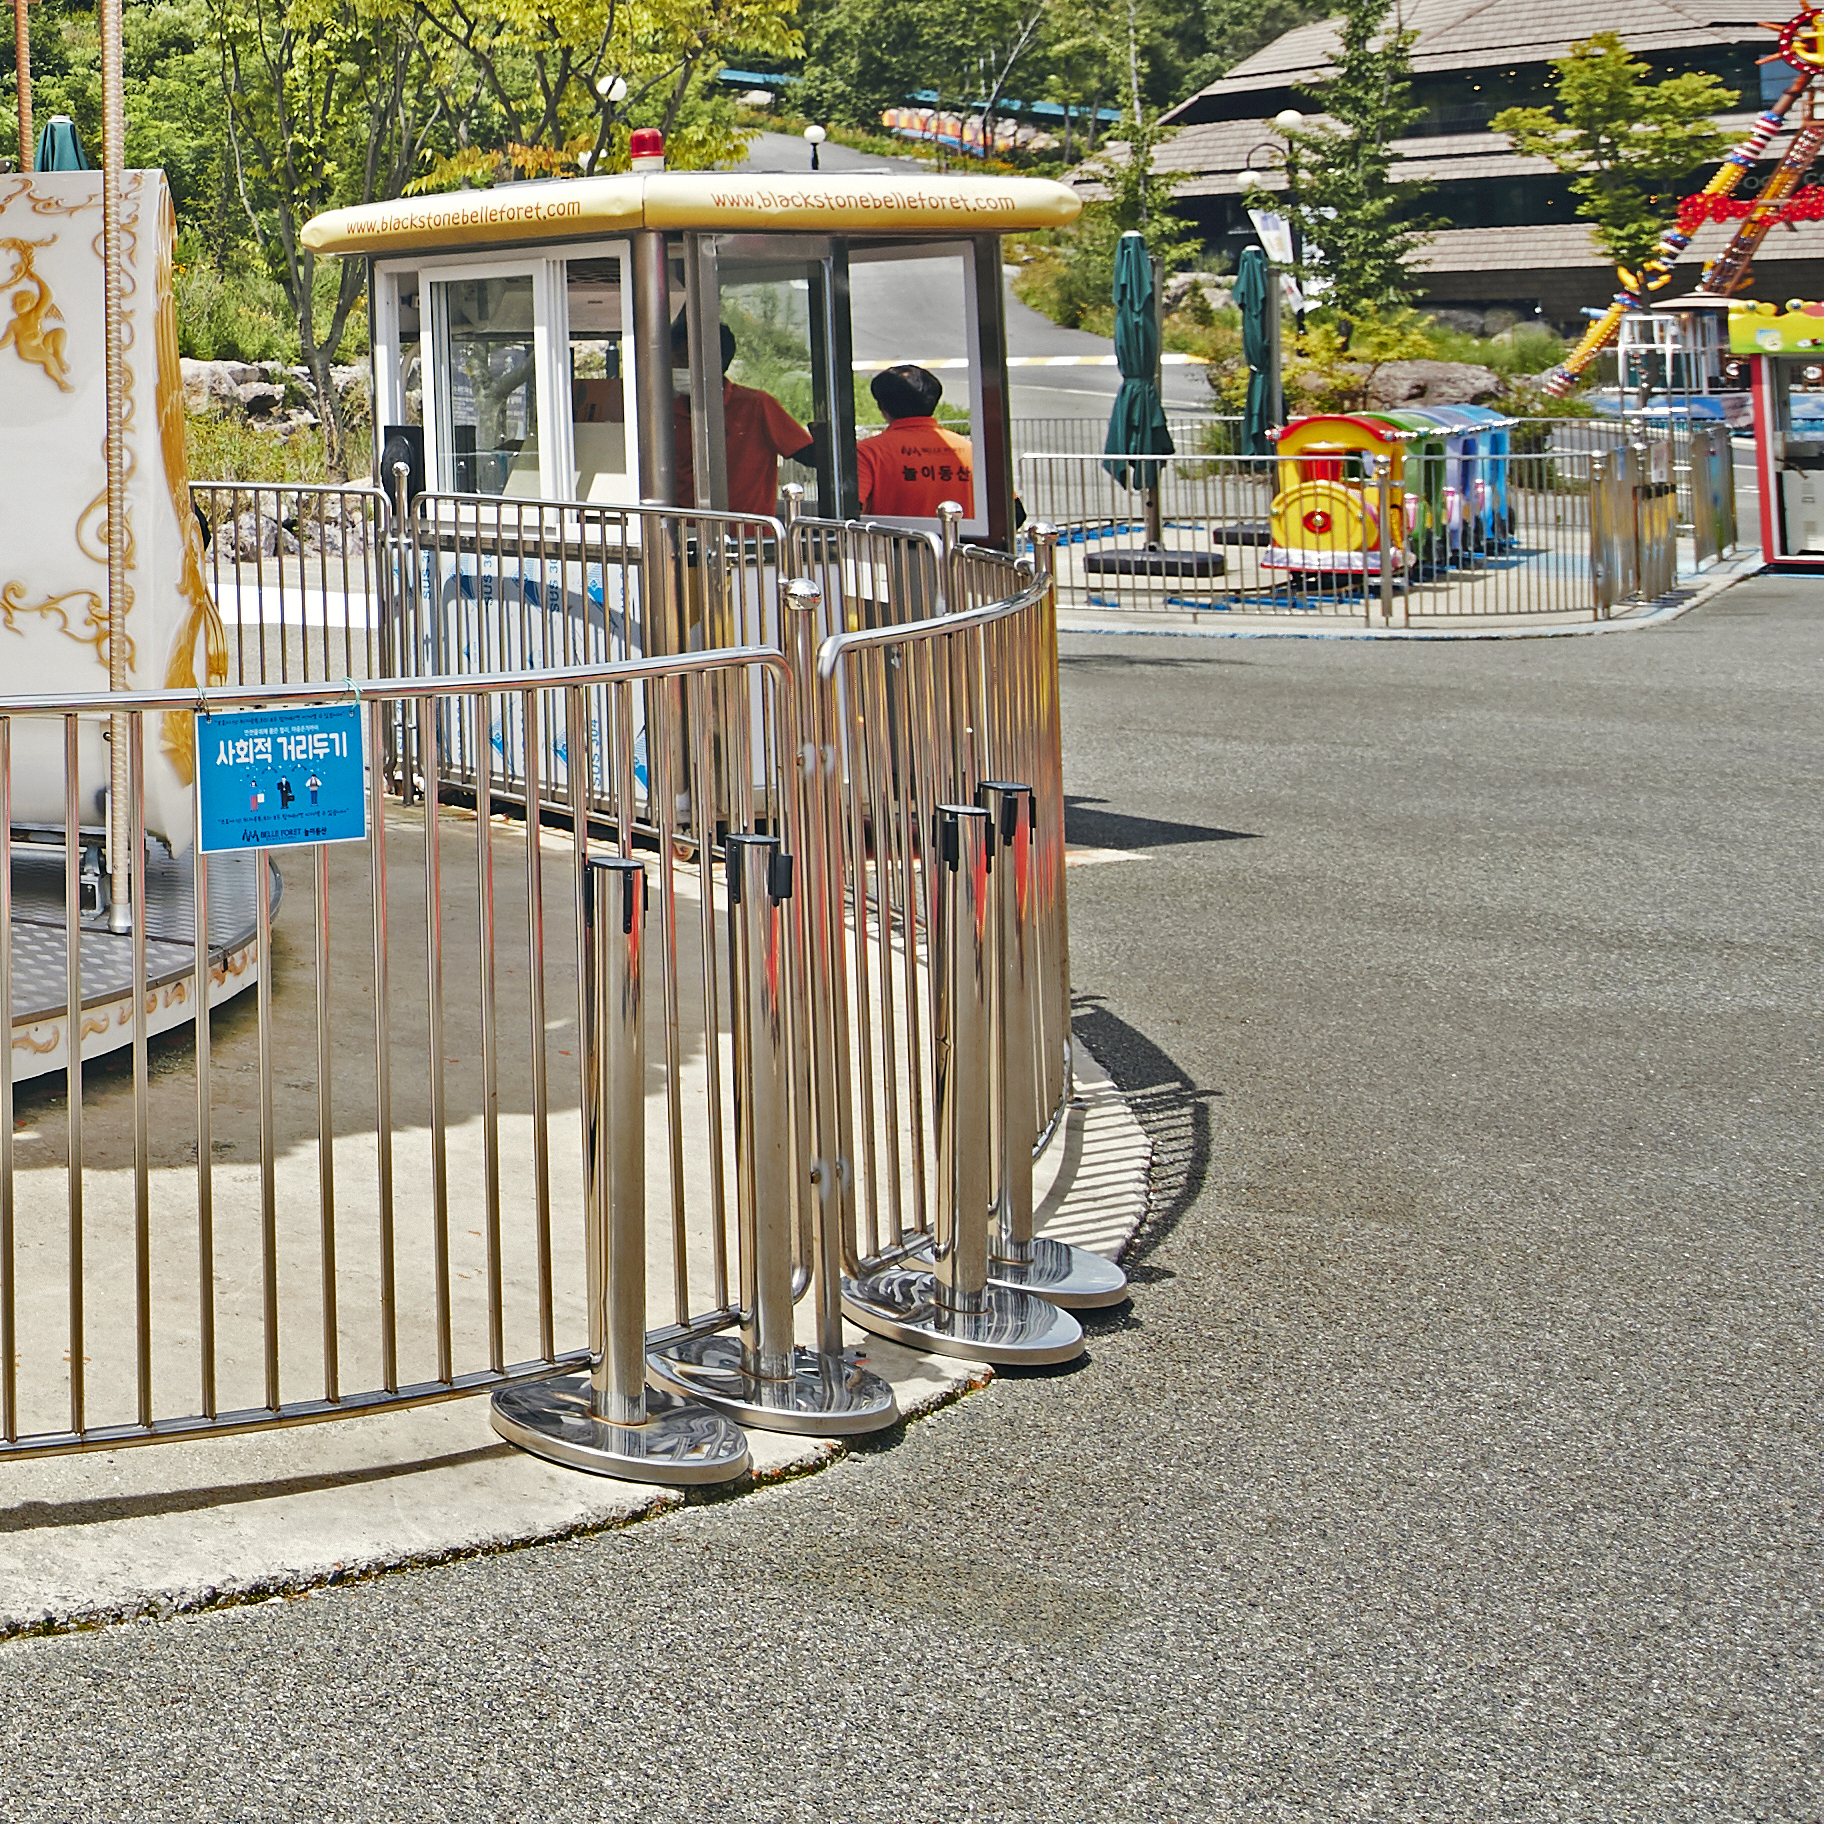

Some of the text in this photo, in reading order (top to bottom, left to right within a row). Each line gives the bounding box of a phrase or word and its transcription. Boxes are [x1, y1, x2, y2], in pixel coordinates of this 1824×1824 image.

[346, 199, 581, 235] www.blackstonebelleforet.com
[710, 191, 1017, 213] www.blackstonebelleforet.com
[902, 465, 971, 482] 놀이동산
[483, 574, 493, 606] SUS
[550, 579, 560, 613] SUS
[216, 731, 348, 766] 사회적 거리두기
[260, 830, 279, 839] BELLE
